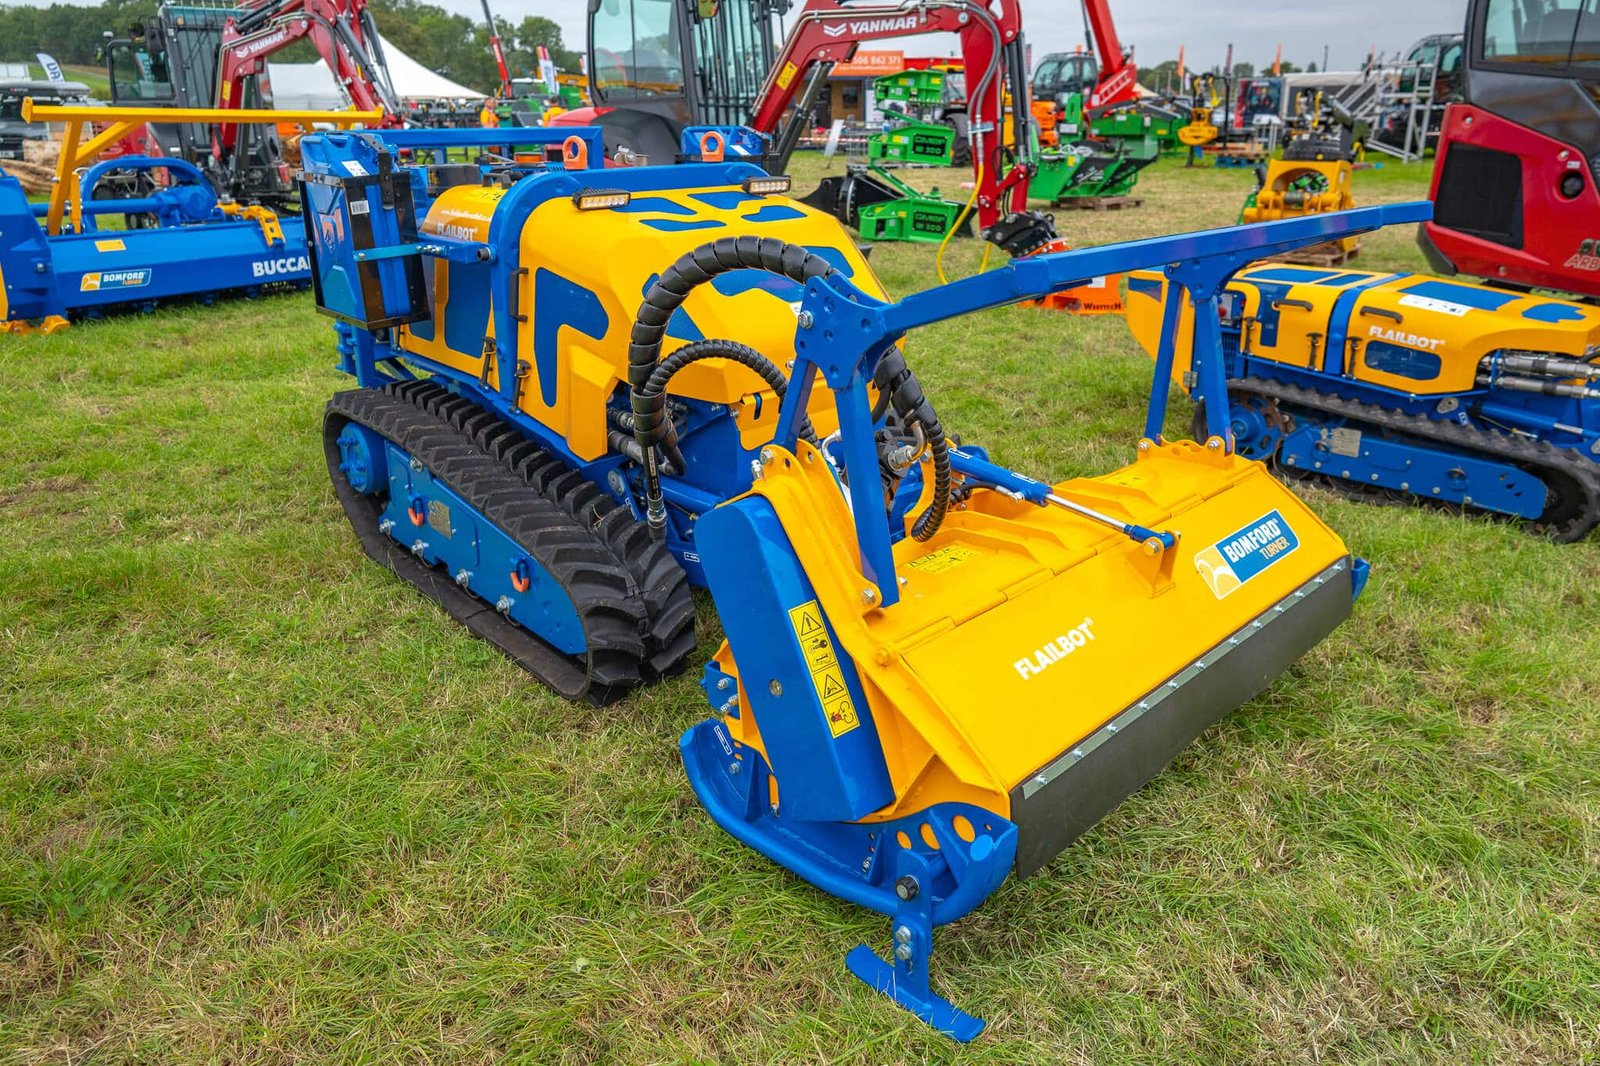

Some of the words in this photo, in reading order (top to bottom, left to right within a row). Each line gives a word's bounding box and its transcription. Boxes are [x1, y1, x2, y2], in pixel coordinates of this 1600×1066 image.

[849, 16, 918, 35] YANMAR
[249, 31, 284, 53] YANMAR
[103, 272, 145, 283] BOMFORD
[1259, 536, 1290, 560] TURNER
